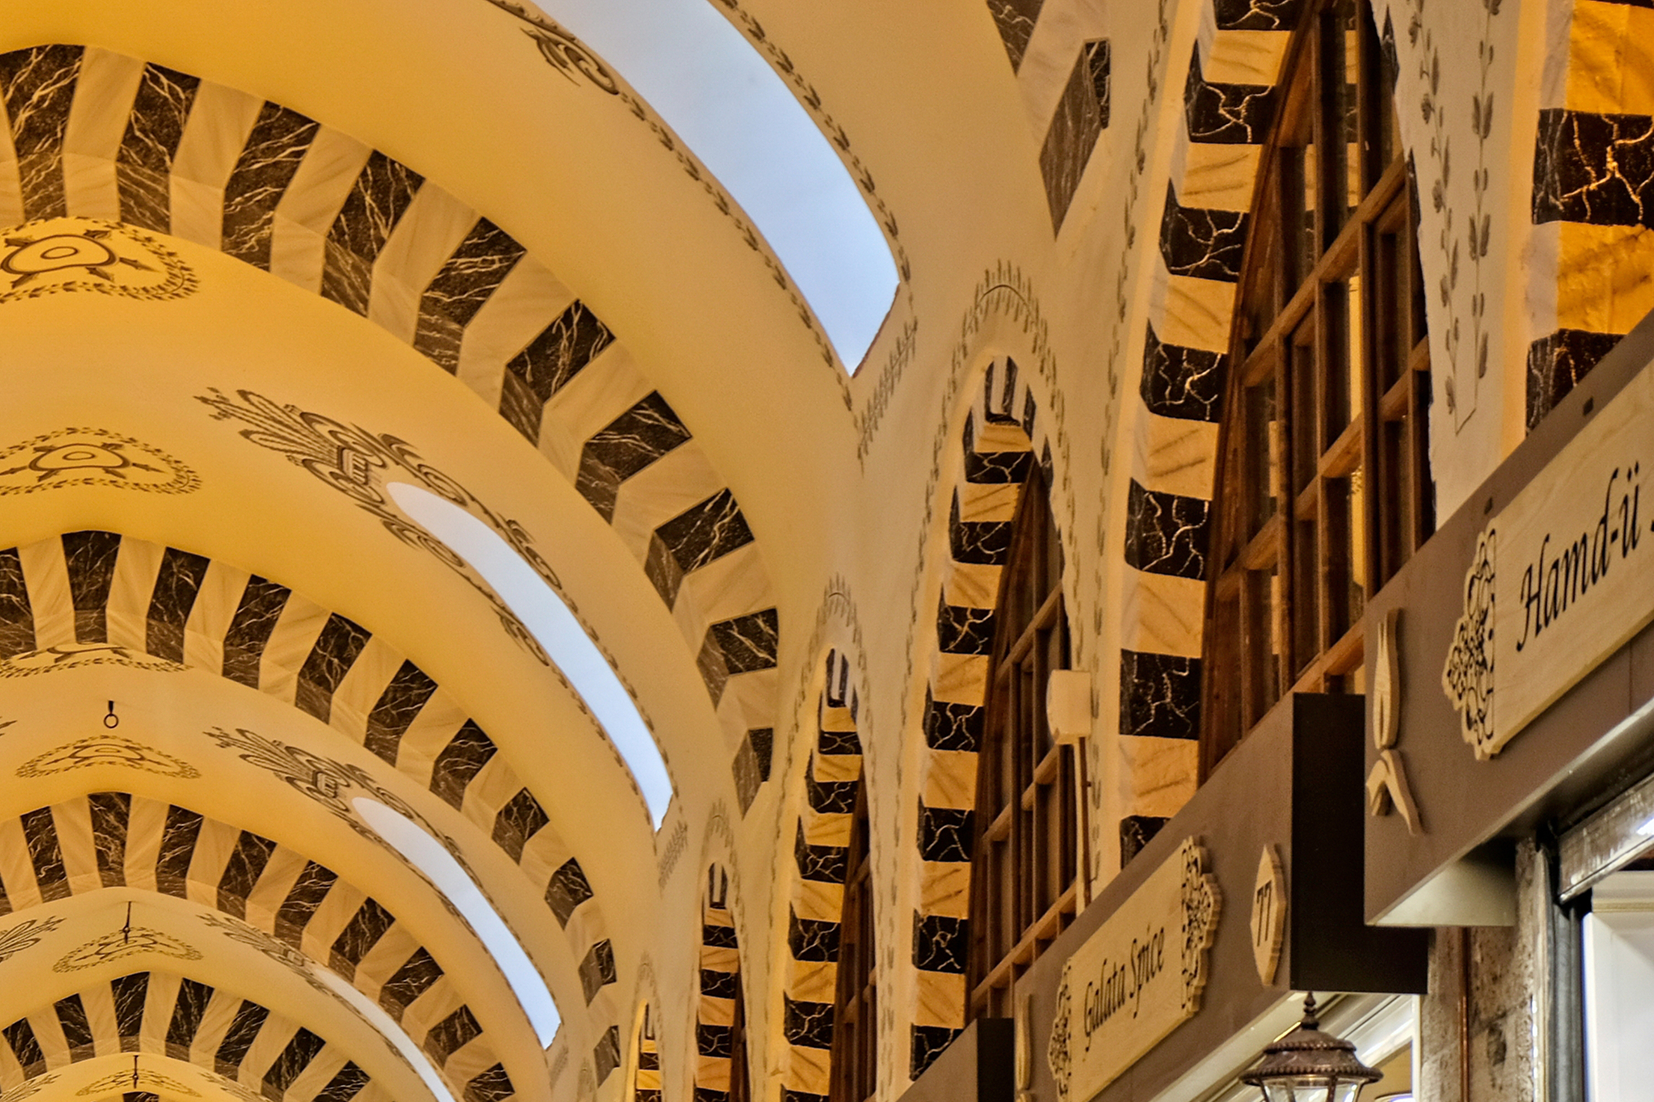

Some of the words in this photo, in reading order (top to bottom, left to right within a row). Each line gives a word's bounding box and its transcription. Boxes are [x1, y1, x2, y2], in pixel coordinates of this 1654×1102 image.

[1516, 461, 1641, 652] Hamd-ü
[1256, 880, 1272, 948] 77
[1084, 958, 1125, 1053] Galata
[1129, 924, 1165, 1020] Spice
